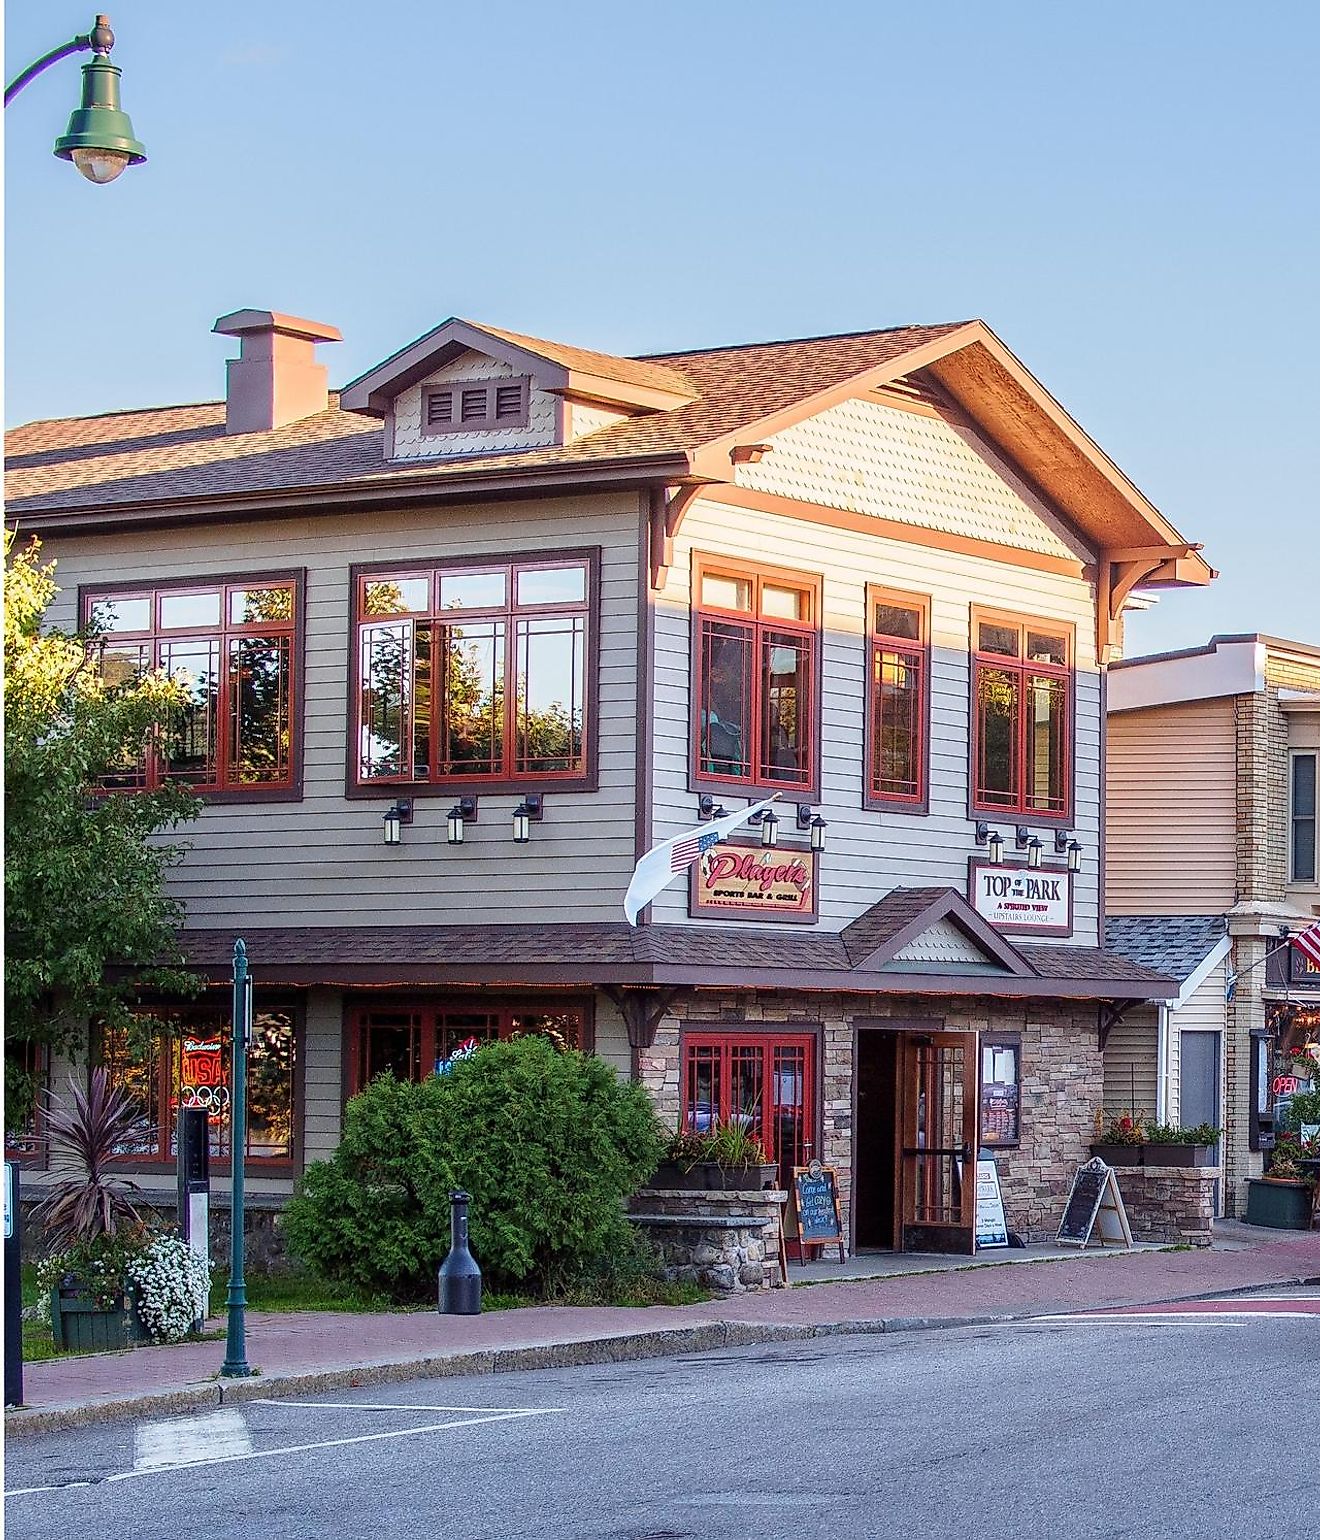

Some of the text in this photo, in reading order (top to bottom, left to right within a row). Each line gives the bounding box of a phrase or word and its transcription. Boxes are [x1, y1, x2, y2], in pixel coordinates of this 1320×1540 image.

[706, 852, 806, 891] Players
[983, 875, 1011, 897] TOP
[1025, 878, 1061, 900] PARK
[713, 889, 745, 898] SPORTS
[747, 891, 765, 900] BAR
[776, 894, 798, 902] GRILL
[1031, 904, 1048, 912] VIEW
[993, 912, 1048, 922] UPSTAIRS LOUNGE
[184, 1041, 222, 1051] Budweiser
[182, 1058, 227, 1085] USA
[1272, 1077, 1298, 1093] OPEN
